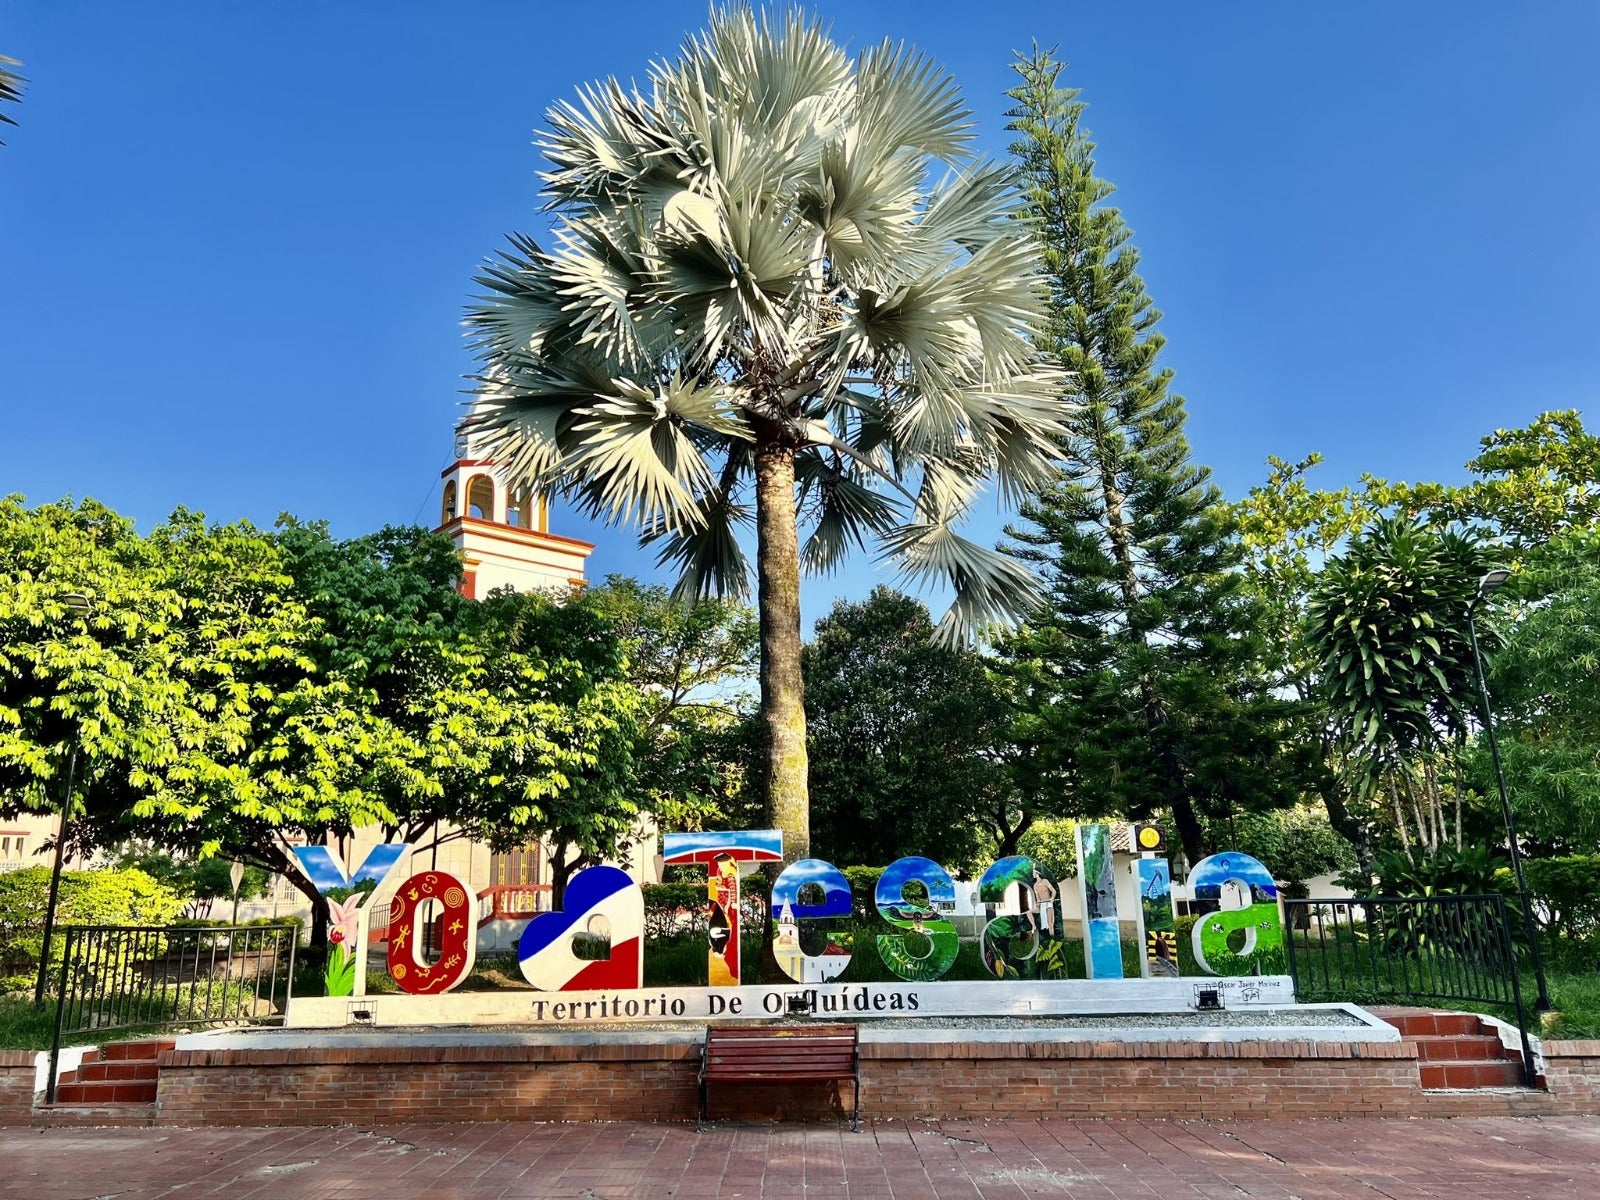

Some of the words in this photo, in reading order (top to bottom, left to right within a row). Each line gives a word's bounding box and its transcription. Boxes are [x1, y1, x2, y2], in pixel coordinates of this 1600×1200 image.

[662, 823, 1288, 986] Tesalia
[532, 994, 686, 1021] Territorio
[707, 994, 742, 1015] De
